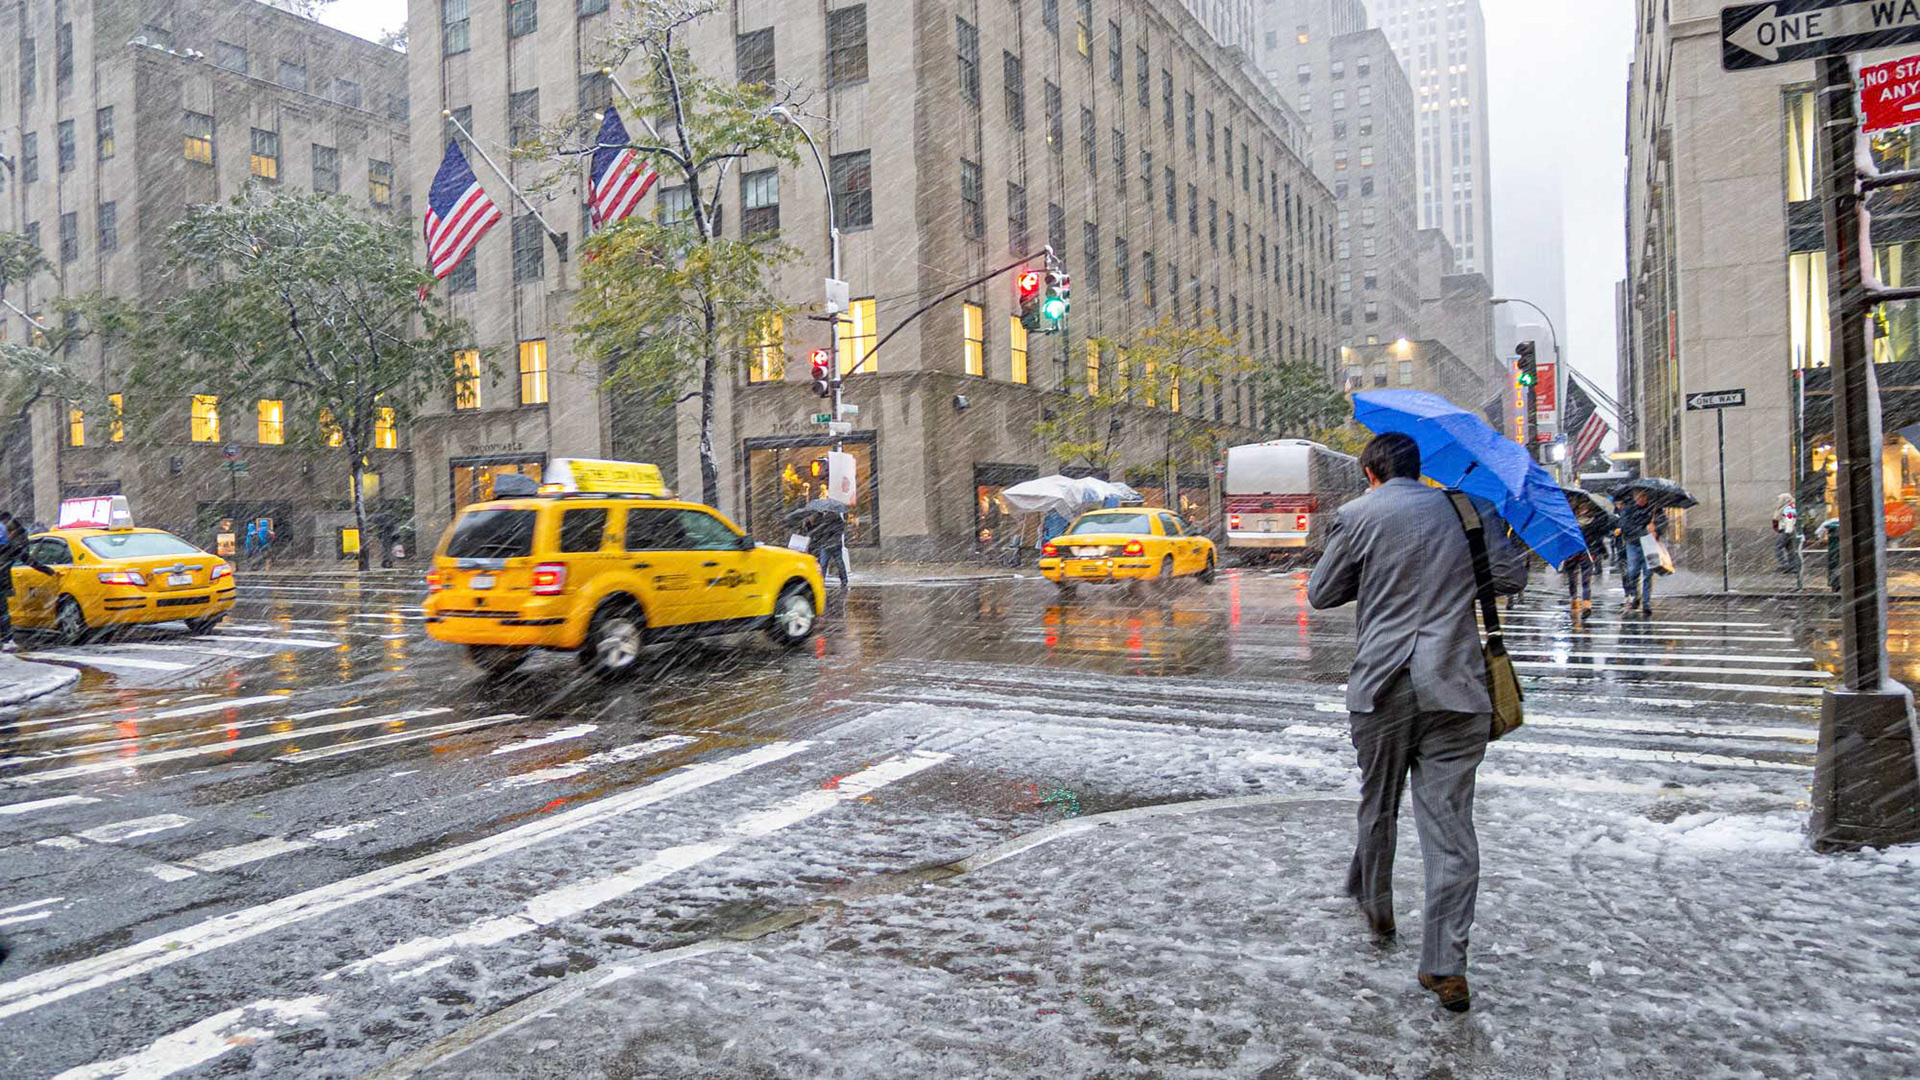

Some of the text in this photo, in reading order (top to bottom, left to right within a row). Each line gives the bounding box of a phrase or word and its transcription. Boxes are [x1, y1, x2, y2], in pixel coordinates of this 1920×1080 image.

[1757, 12, 1824, 46] ONE
[1866, 69, 1888, 86] NO
[1696, 394, 1737, 404] ONE WAY
[1515, 415, 1525, 444] CIT
